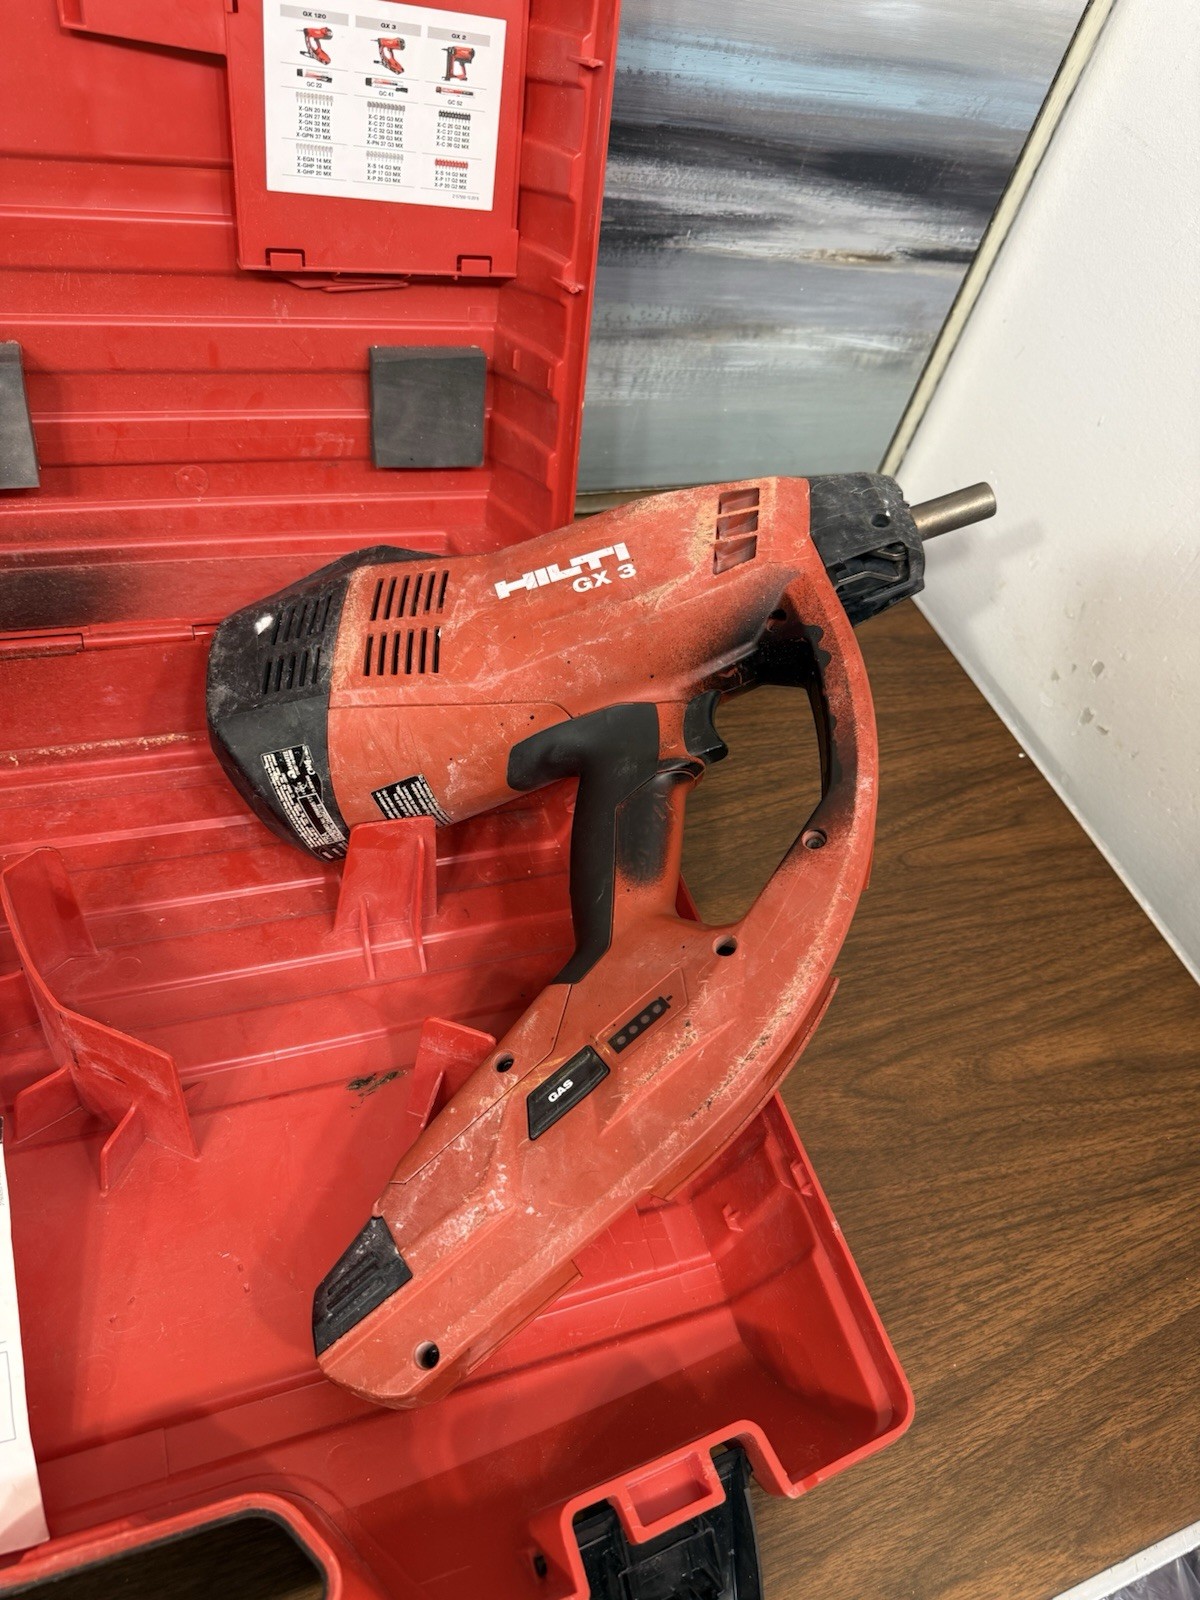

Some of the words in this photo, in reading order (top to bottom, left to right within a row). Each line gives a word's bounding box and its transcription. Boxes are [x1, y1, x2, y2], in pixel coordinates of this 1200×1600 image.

[494, 542, 631, 600] HILTI
[572, 570, 612, 593] GX
[617, 563, 636, 579] 3
[548, 1079, 574, 1102] GAS
